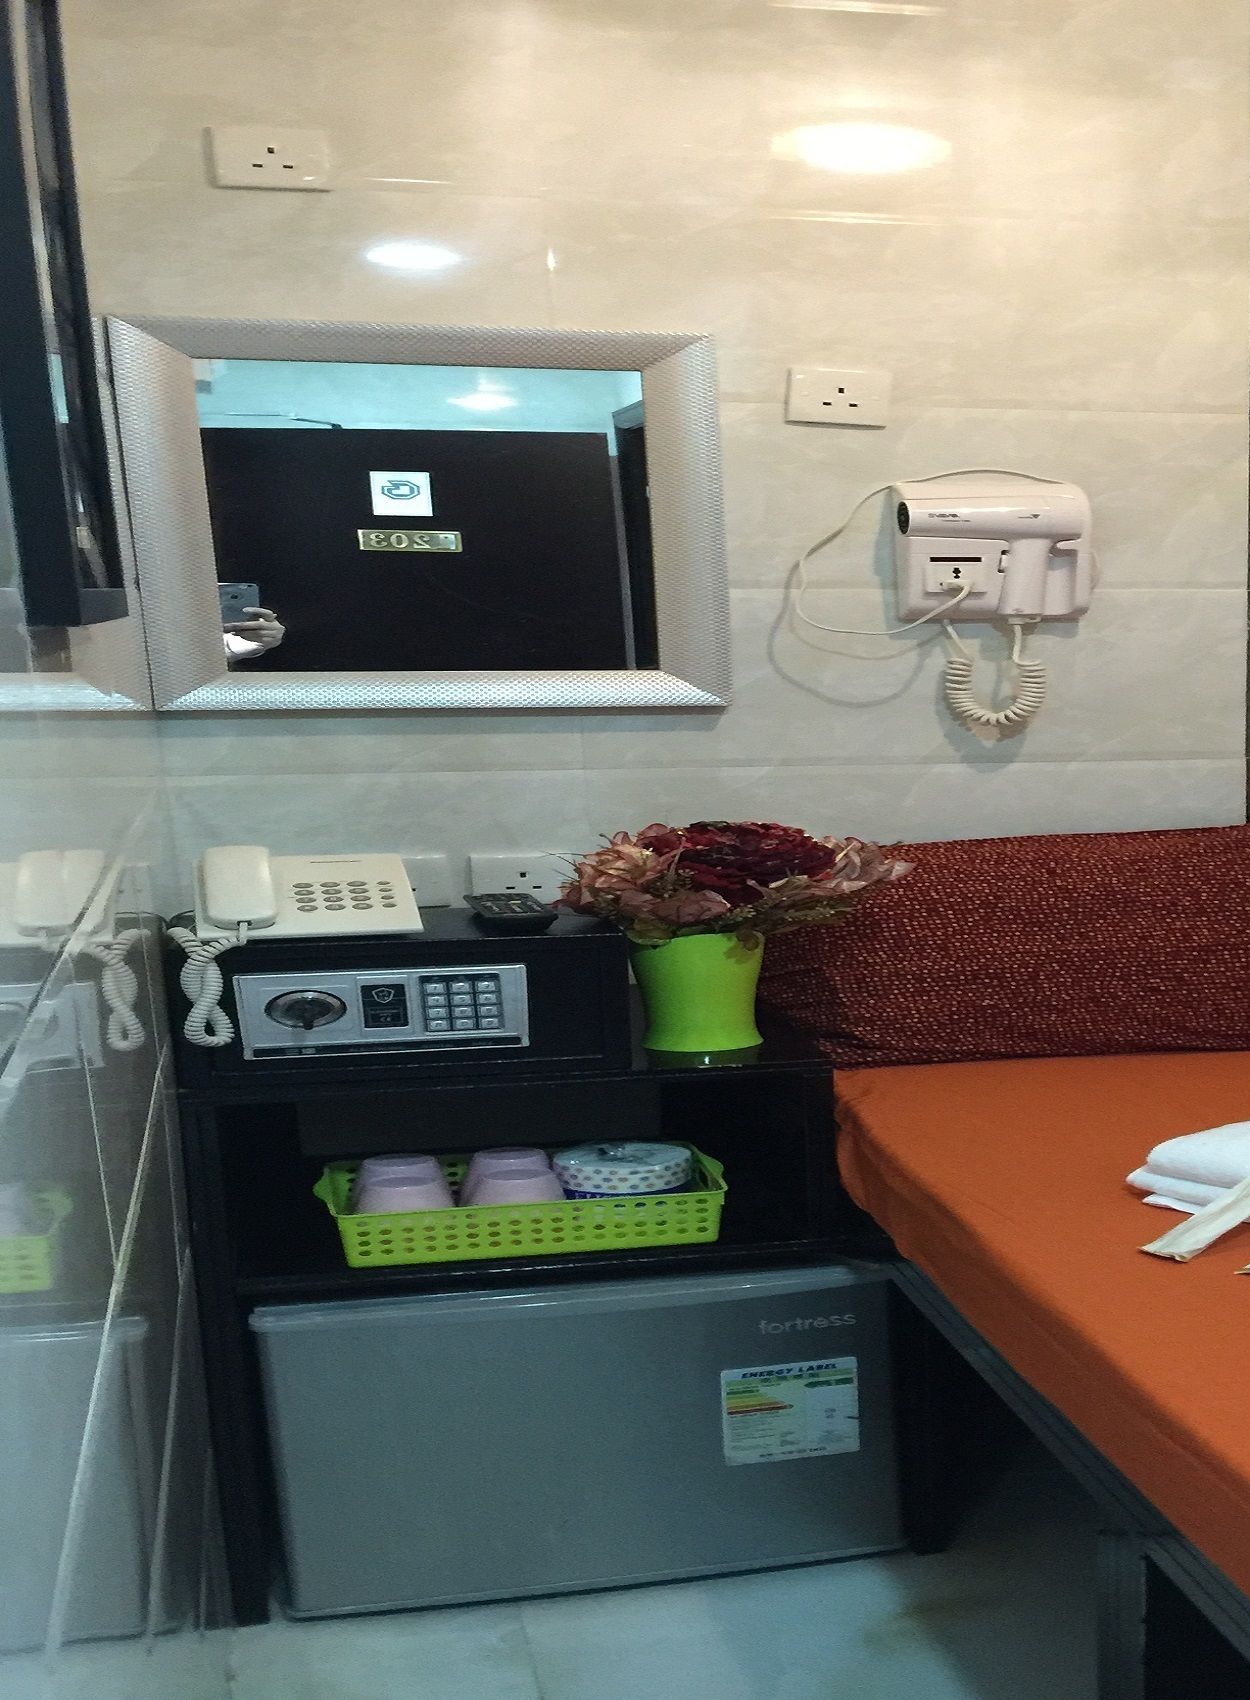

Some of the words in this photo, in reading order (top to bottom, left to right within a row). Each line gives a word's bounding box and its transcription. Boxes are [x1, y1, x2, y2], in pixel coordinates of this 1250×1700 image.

[758, 1314, 857, 1335] fortress
[741, 1367, 794, 1379] ENERGY
[798, 1363, 838, 1373] LABEL
